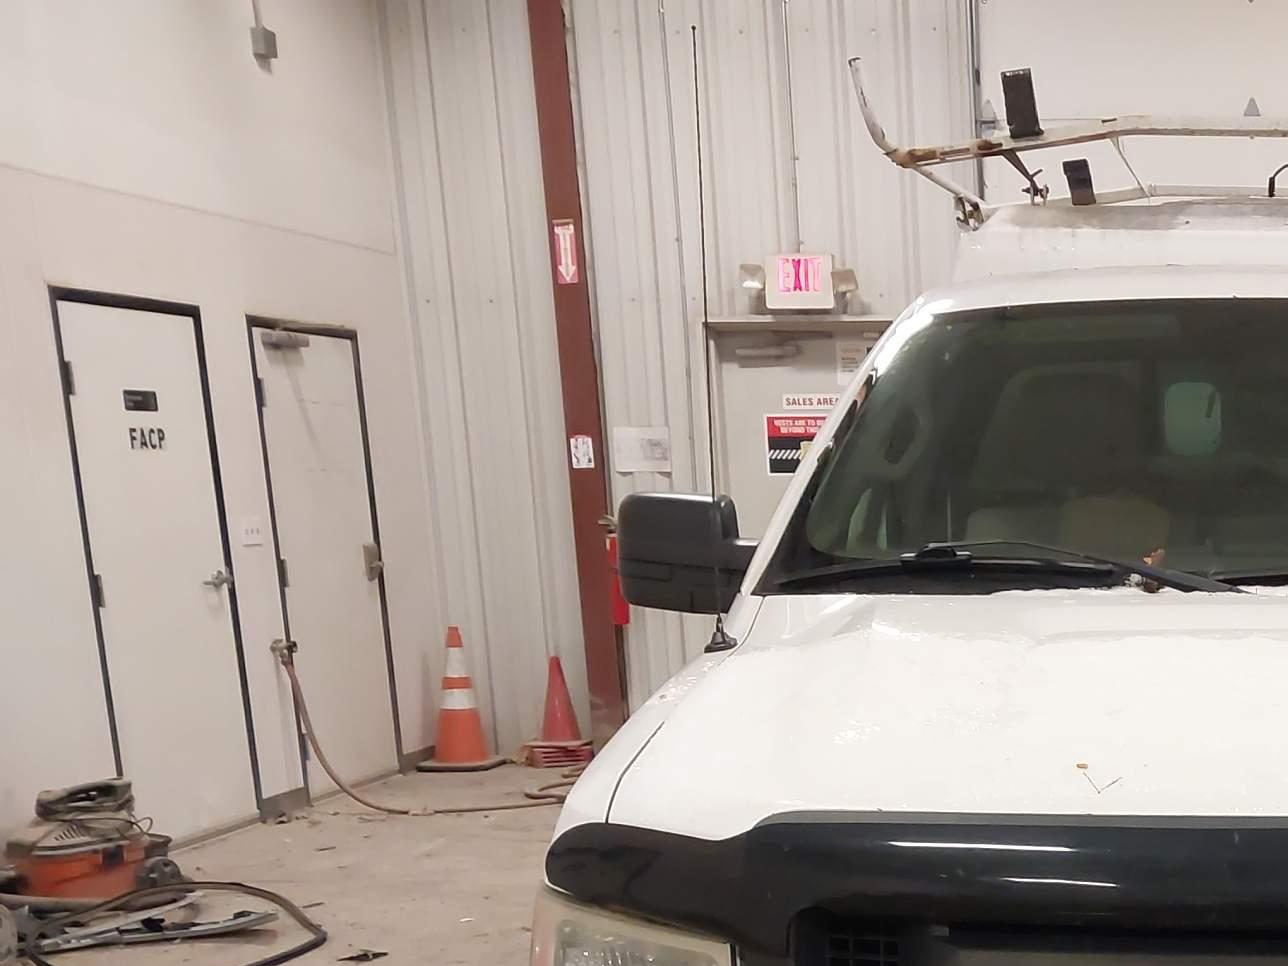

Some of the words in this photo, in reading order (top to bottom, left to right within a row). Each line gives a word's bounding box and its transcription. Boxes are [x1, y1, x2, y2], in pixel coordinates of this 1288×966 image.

[778, 257, 822, 292] EXIT
[785, 397, 813, 406] SALES
[129, 427, 165, 450] FACP
